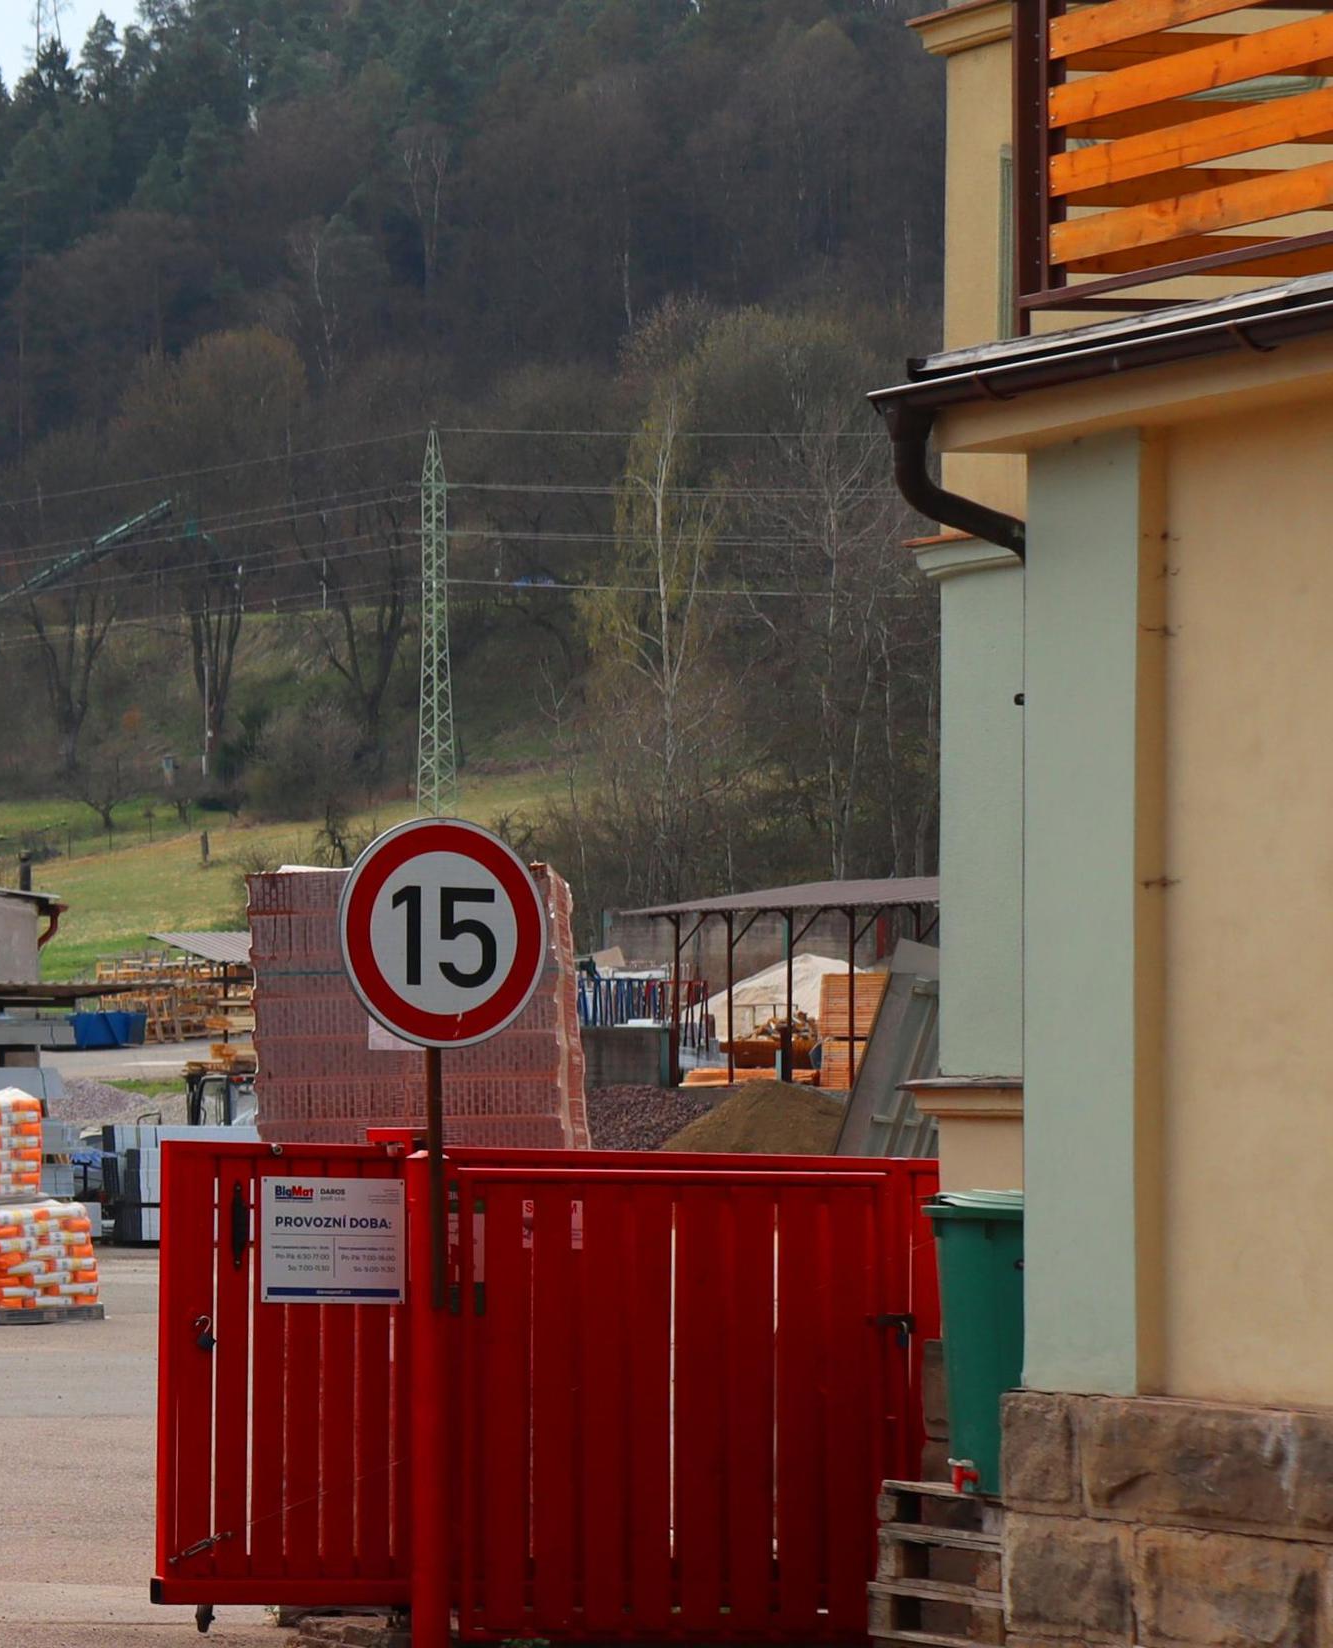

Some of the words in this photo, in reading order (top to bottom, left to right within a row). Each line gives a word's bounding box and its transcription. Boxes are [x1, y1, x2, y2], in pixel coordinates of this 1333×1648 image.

[392, 885, 497, 988] 15
[275, 1214, 347, 1229] PROVOZNÍ
[349, 1217, 393, 1230] DOBA:
